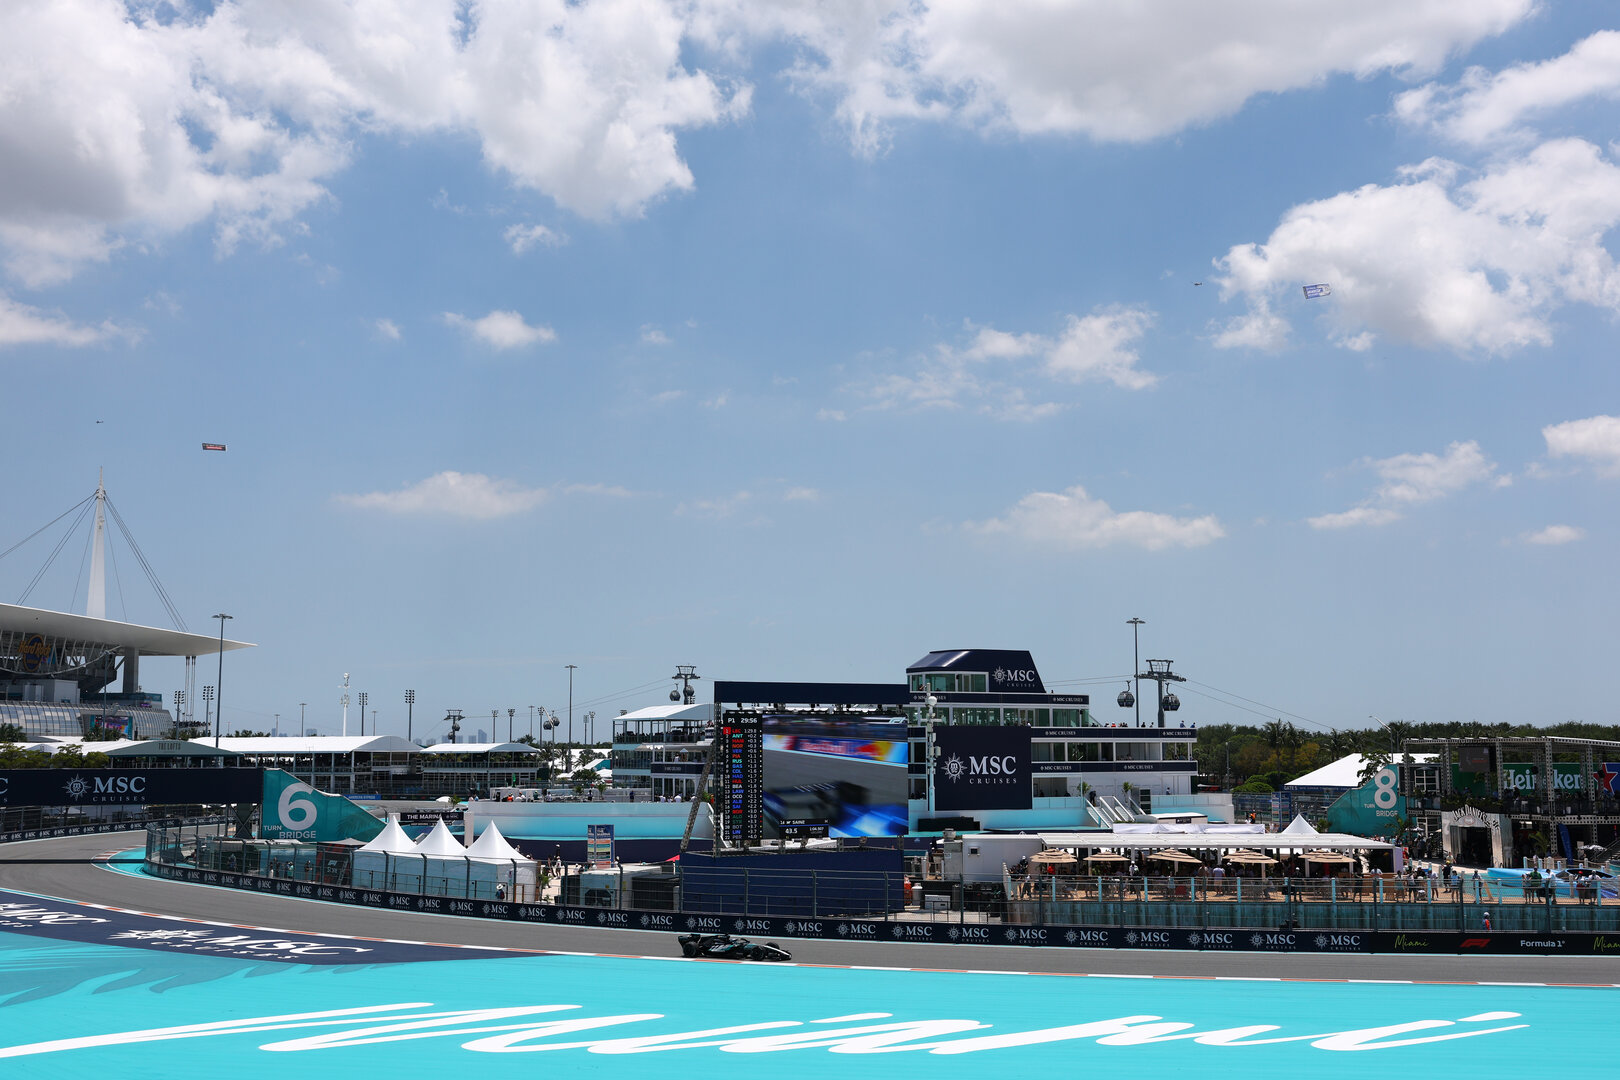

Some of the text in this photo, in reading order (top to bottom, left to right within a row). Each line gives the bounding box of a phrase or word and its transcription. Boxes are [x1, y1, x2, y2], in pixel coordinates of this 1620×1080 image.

[17, 640, 51, 658] Hard Rock
[1007, 670, 1035, 681] MSC
[969, 756, 1016, 775] MSC
[93, 777, 145, 793] MSC
[1375, 769, 1396, 809] 8
[278, 782, 317, 830] 6
[344, 891, 356, 899] MSC
[369, 894, 381, 902] MSC
[396, 897, 410, 905] MSC
[425, 900, 440, 908] MSC
[456, 902, 473, 910] MSC
[490, 904, 508, 913] MSC
[528, 907, 546, 917] MSC
[566, 910, 585, 919] MSC
[608, 913, 628, 922] MSC
[652, 915, 672, 925] MSC
[698, 918, 720, 927] MSC
[747, 920, 770, 930] MSC
[798, 922, 822, 932] MSC
[850, 924, 876, 934] MSC
[906, 926, 932, 936] MSC
[962, 928, 989, 938] MSC
[1020, 929, 1047, 939] MSC
[1080, 931, 1108, 940] MSC
[1141, 932, 1169, 942] MSC
[1204, 933, 1232, 943] MSC
[1266, 934, 1295, 944] MSC
[1330, 935, 1360, 946] MSC
[1395, 934, 1429, 949] Miami
[1594, 936, 1620, 952] Miam
[184, 935, 374, 955] MSC
